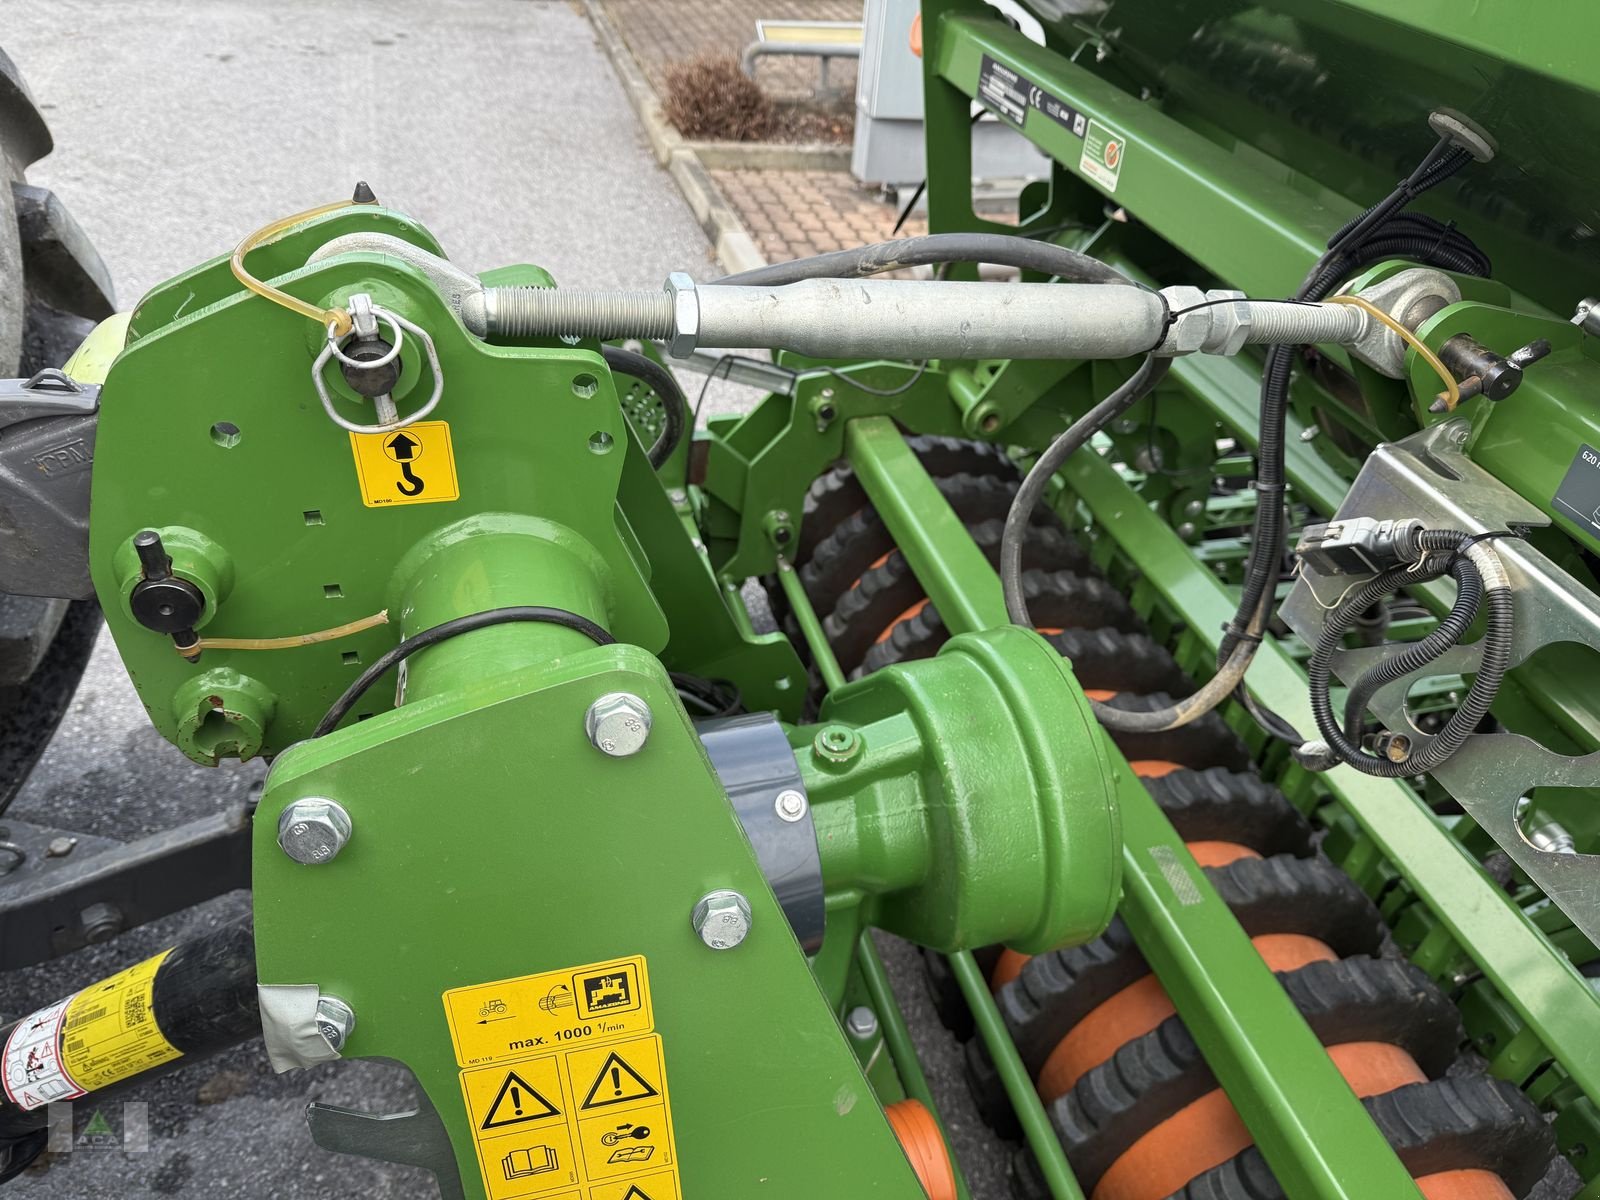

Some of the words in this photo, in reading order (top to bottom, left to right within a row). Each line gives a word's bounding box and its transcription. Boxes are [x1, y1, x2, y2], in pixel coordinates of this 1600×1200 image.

[1582, 450, 1598, 465] 620
[588, 999, 630, 1012] AMAZONE
[509, 1036, 548, 1050] max.
[554, 1025, 592, 1042] 1000
